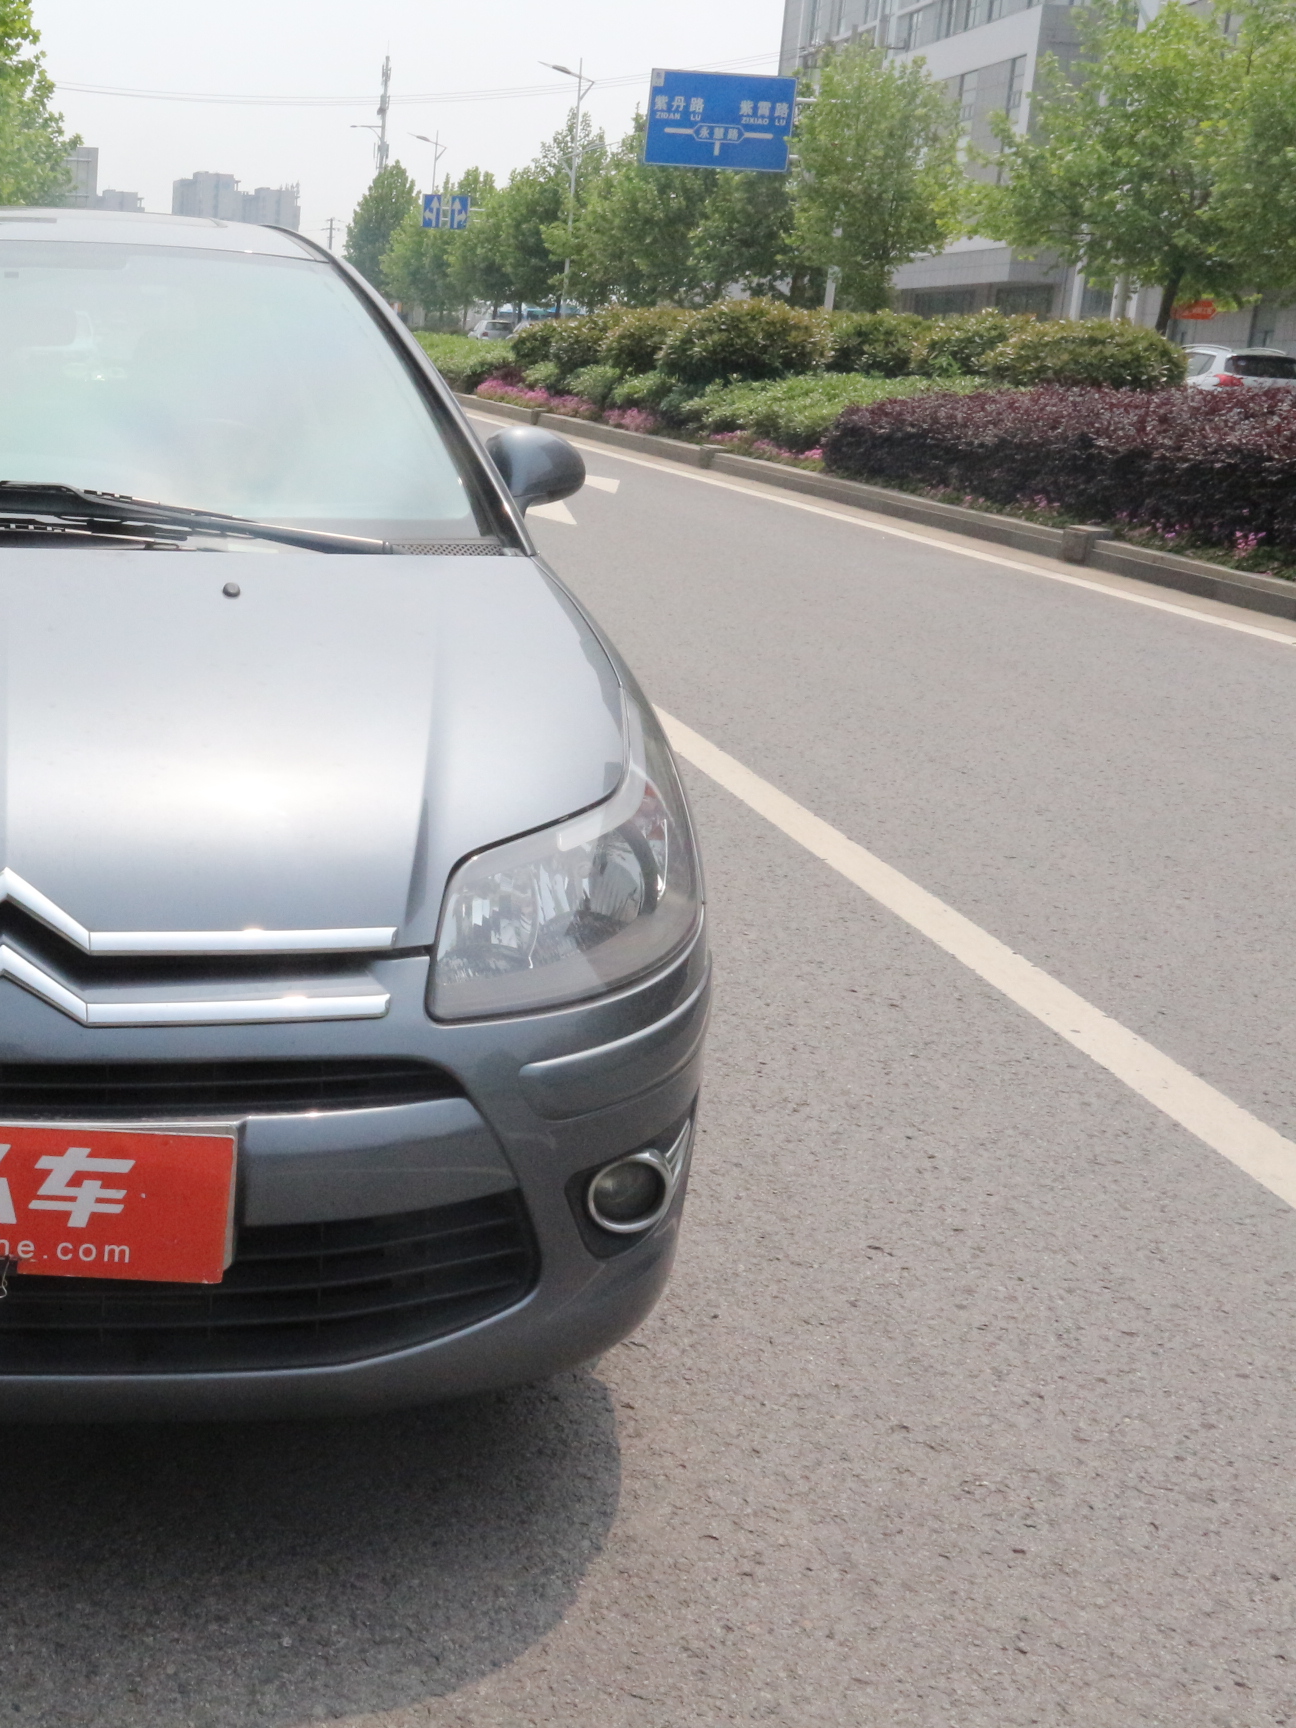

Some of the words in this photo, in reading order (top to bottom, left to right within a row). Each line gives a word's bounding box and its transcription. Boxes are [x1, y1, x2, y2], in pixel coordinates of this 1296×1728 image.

[654, 95, 705, 113] 紫丹路
[656, 112, 681, 120] ZIDAN
[741, 117, 769, 125] ZIXIAO
